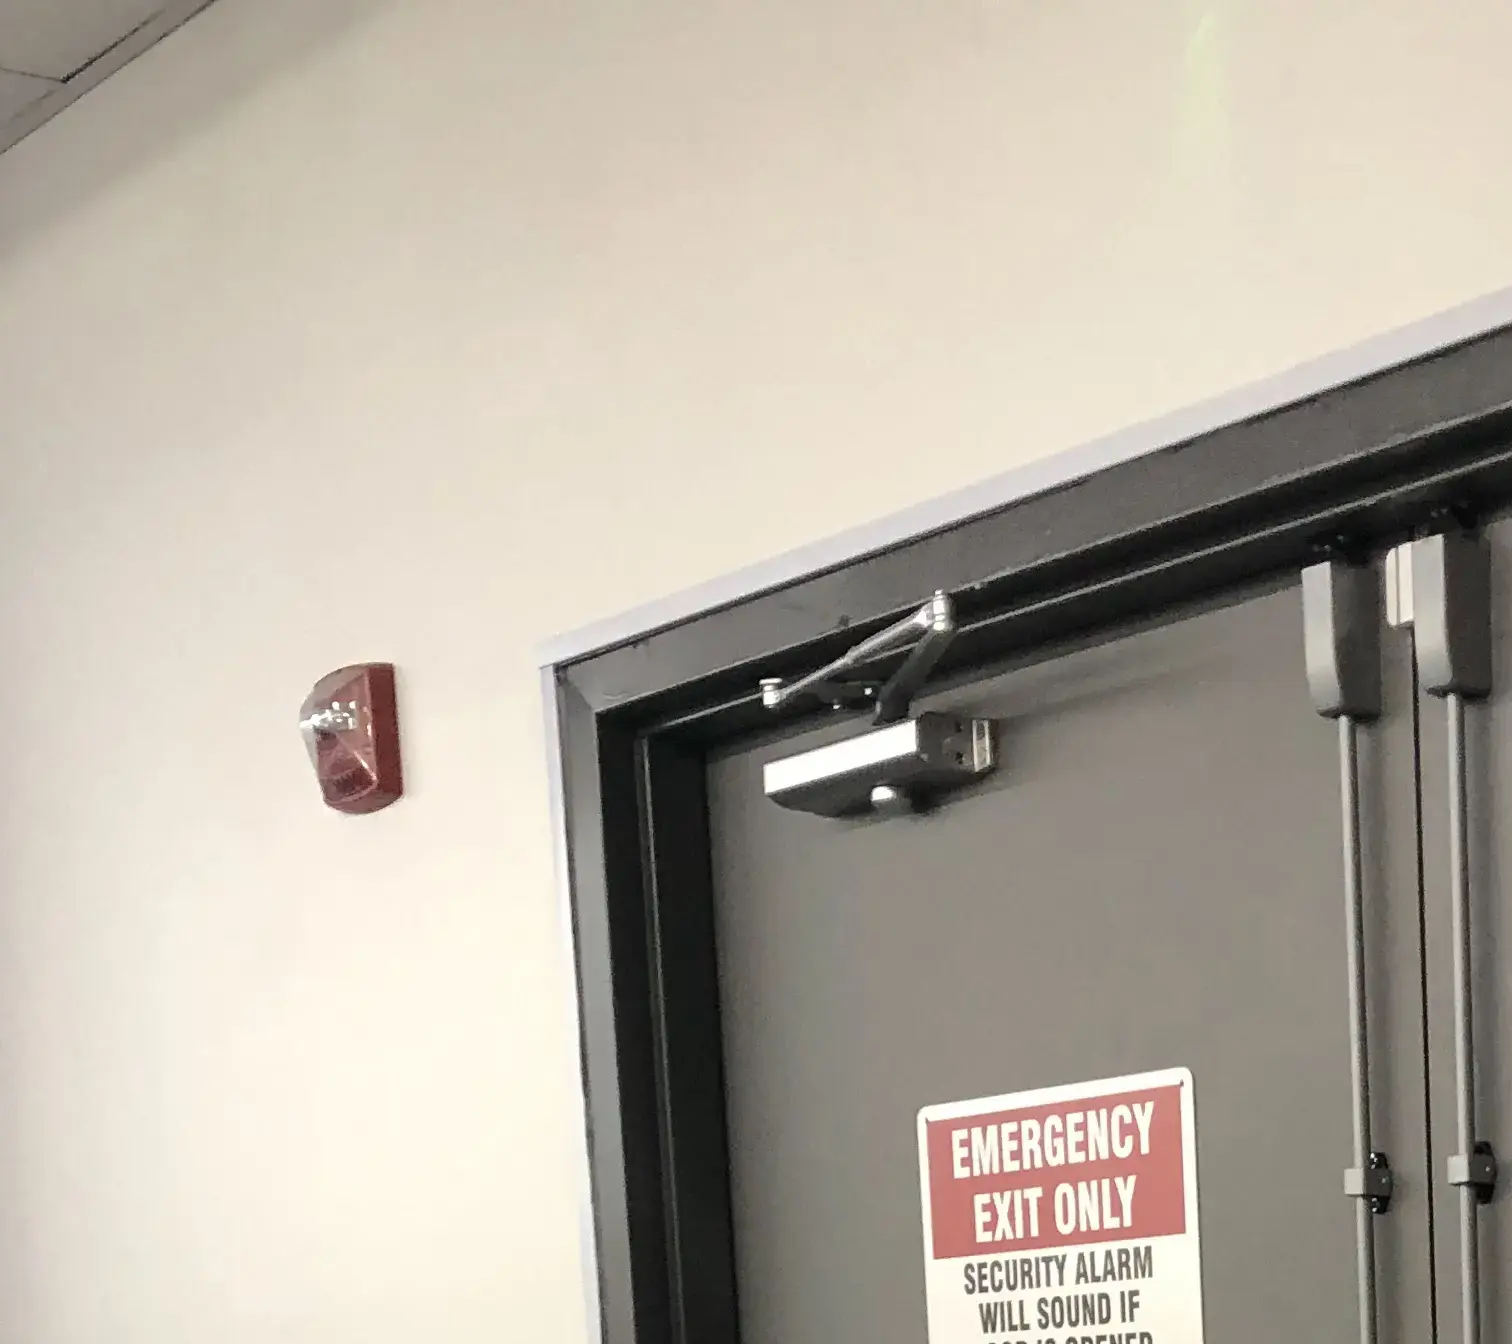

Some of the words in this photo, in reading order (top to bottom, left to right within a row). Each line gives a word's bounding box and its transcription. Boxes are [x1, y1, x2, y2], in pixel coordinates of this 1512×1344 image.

[951, 1101, 1155, 1180] EMERGENCY
[973, 1186, 1043, 1243] EXIT
[1054, 1175, 1137, 1236] ONLY
[964, 1254, 1067, 1295] SECURITY
[1075, 1246, 1153, 1286] ALARM
[978, 1300, 1030, 1335] WILL
[1037, 1292, 1111, 1330] SOUND
[1120, 1289, 1140, 1323] IF
